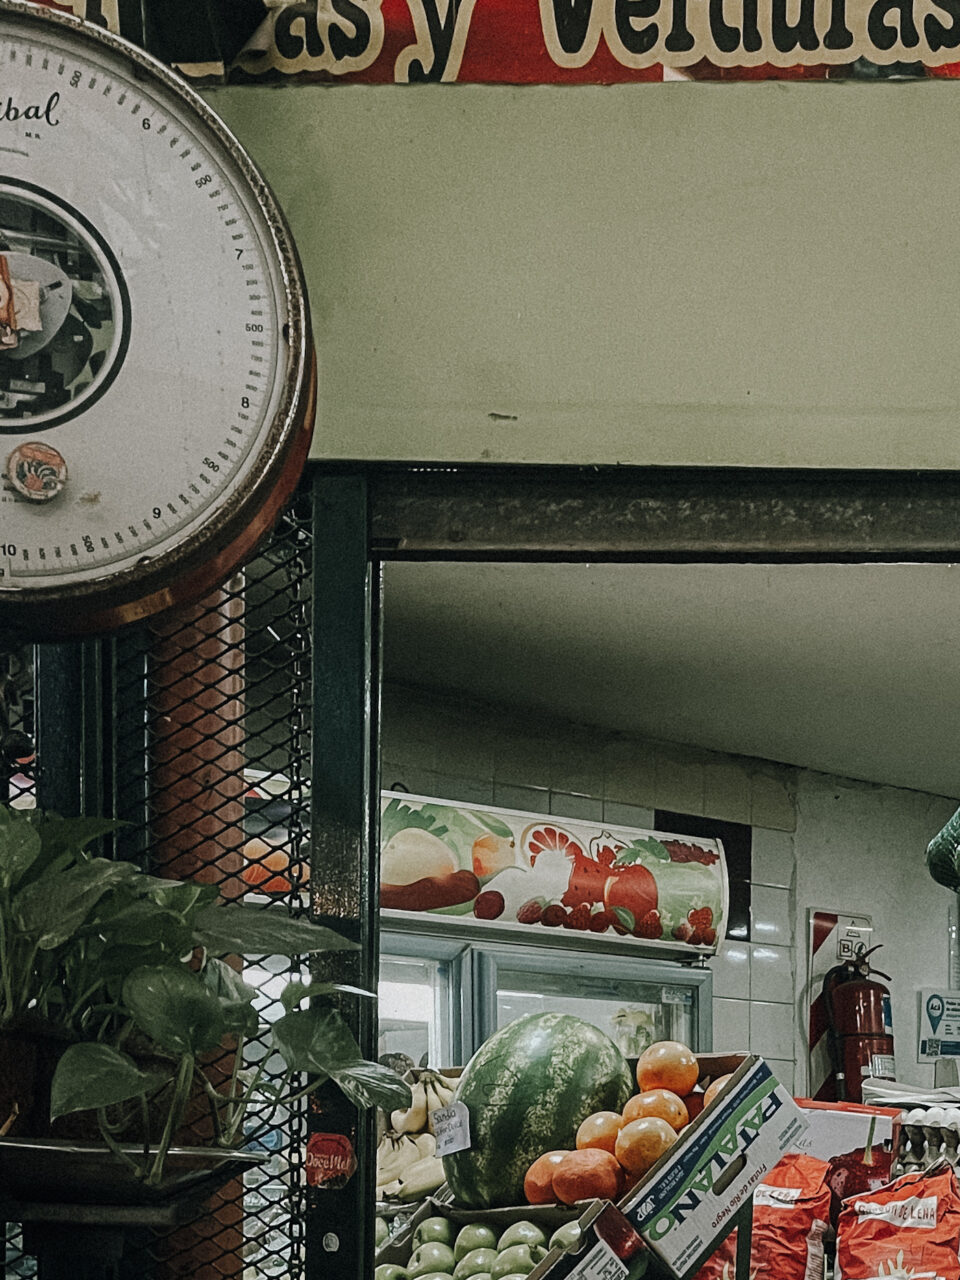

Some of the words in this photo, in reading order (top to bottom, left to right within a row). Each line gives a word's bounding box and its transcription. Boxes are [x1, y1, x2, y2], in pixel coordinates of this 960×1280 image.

[69, 70, 82, 89] 500
[0, 91, 61, 127] bal
[142, 117, 151, 130] 6
[195, 174, 213, 189] 500
[234, 248, 244, 260] 7
[245, 323, 264, 333] 500
[241, 396, 250, 409] 8
[202, 457, 220, 473] 500
[152, 507, 162, 519] 9
[0, 544, 17, 556] 10
[81, 535, 95, 553] 500
[645, 1090, 783, 1243] PATALANO
[745, 1162, 769, 1188] Frutas
[709, 1204, 733, 1230] Negro
